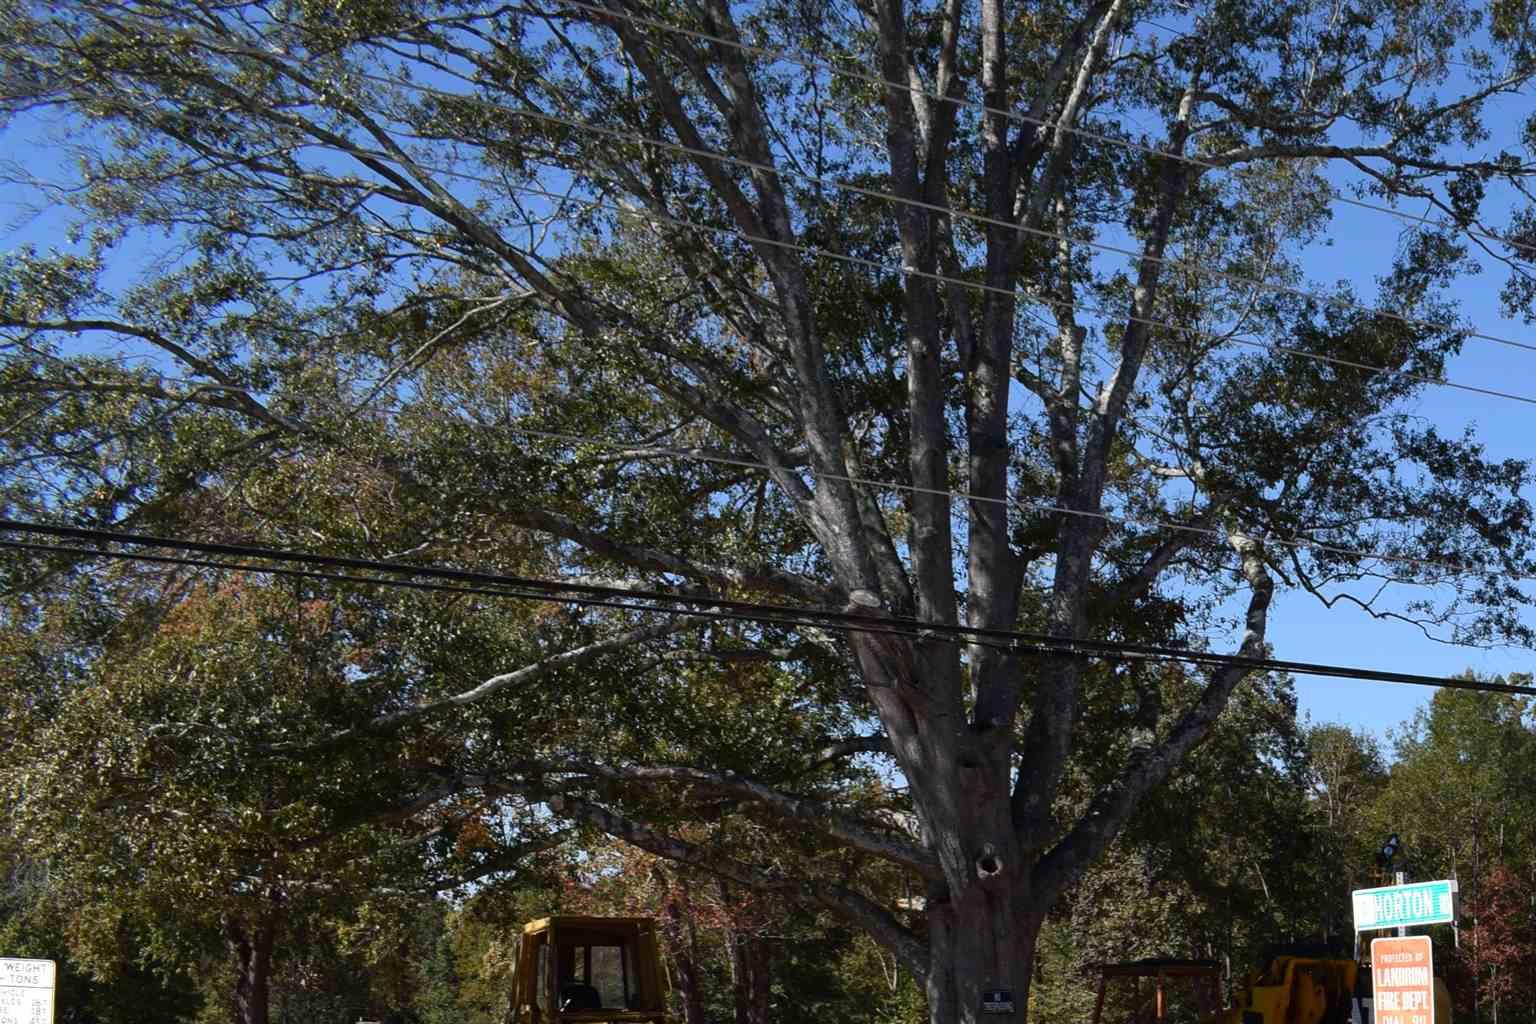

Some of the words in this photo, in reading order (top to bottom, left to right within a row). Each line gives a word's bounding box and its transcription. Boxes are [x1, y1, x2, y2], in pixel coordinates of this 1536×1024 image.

[1374, 887, 1433, 921] HORTON
[3, 963, 47, 973] WEIGHT
[1377, 966, 1428, 987] LANDRUM
[10, 975, 39, 984] TONS
[1378, 991, 1403, 1011] FIRE
